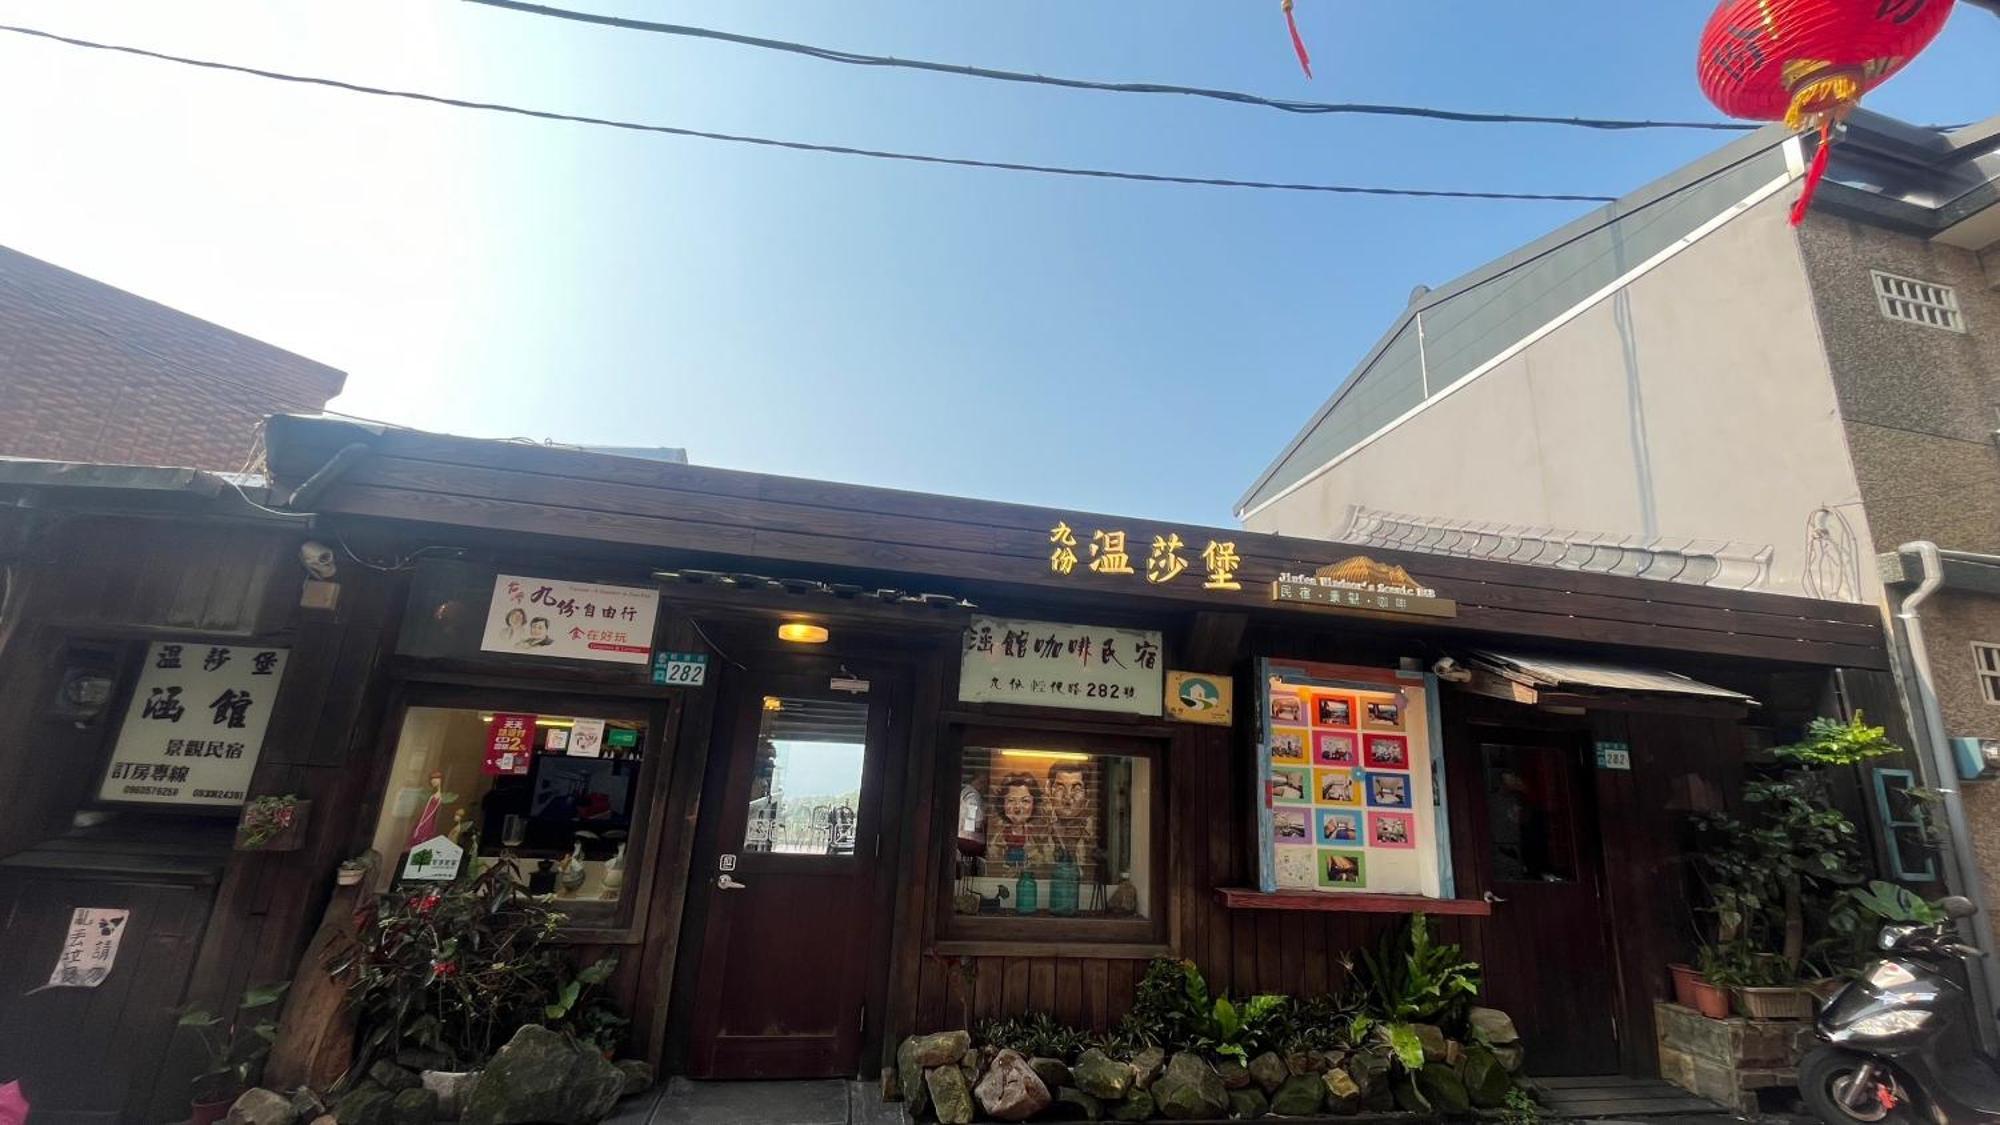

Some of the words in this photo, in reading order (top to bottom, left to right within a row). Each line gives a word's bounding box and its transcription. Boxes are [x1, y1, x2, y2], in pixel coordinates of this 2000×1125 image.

[1050, 521, 1078, 576] 九份
[967, 625, 1162, 671] 涵館咖啡民宿
[668, 664, 703, 682] 282
[142, 686, 253, 729] 涵館
[165, 739, 245, 759] 景觀民宿
[111, 761, 190, 783] 訂房專線
